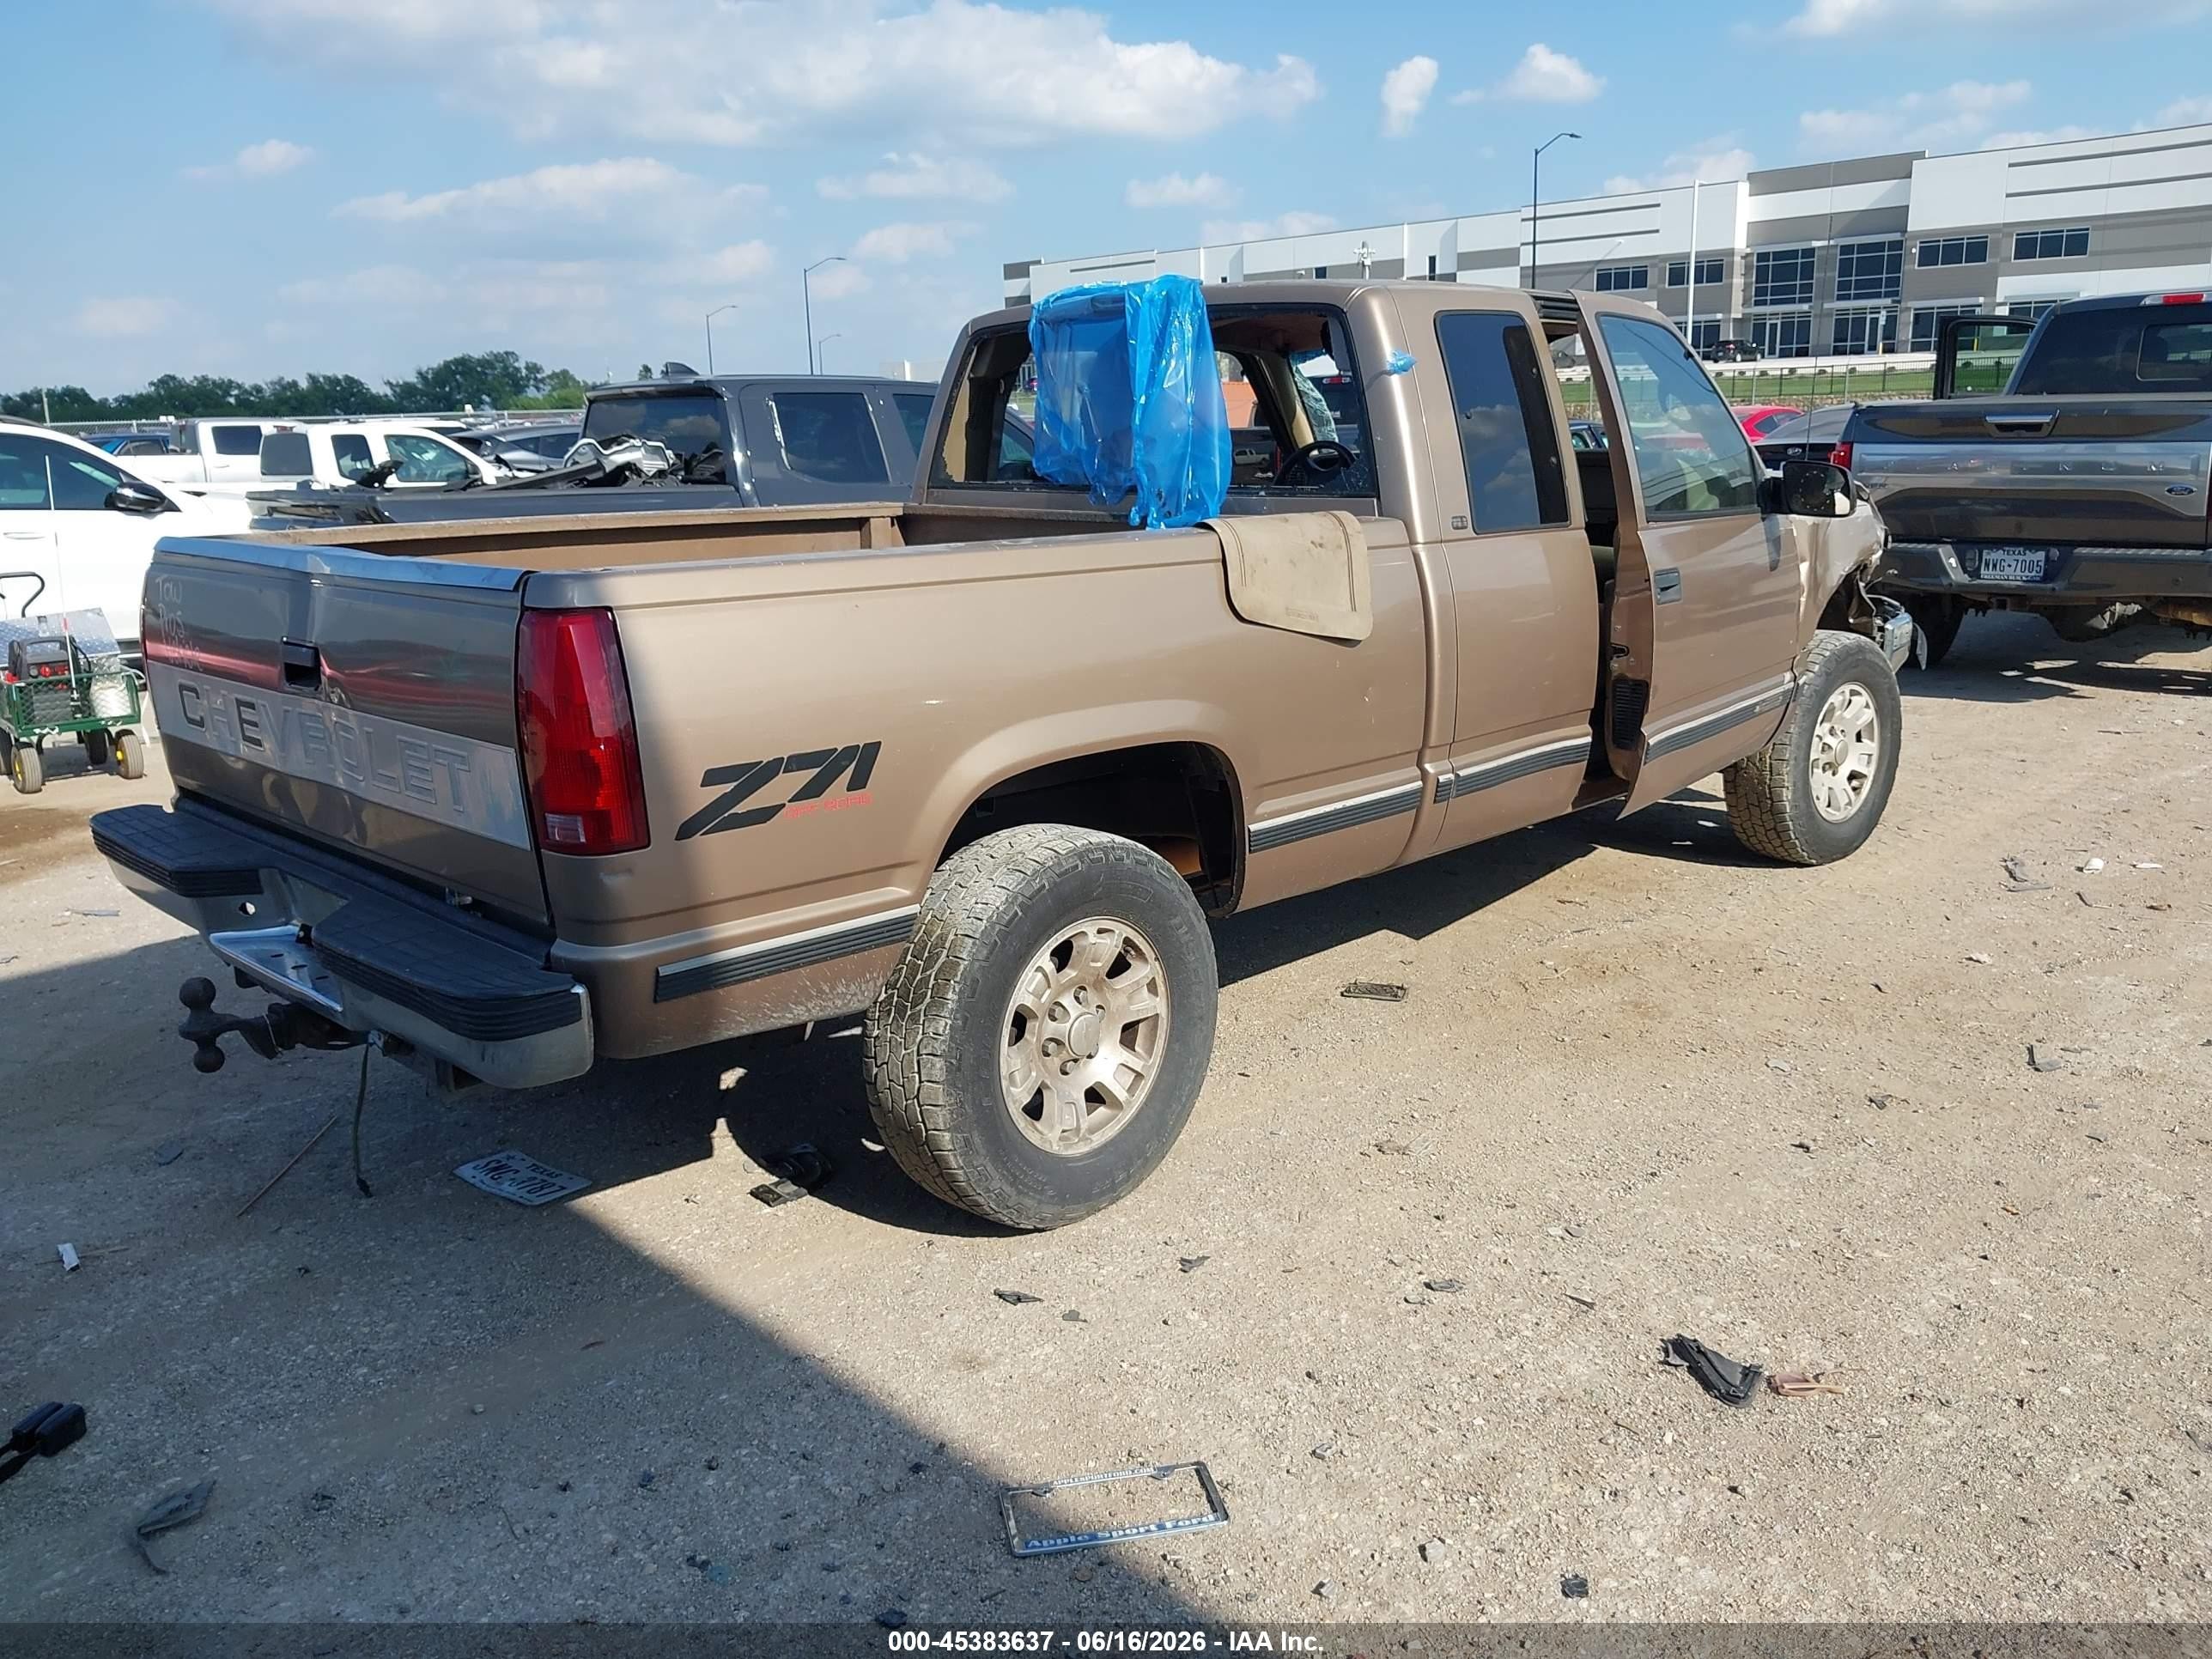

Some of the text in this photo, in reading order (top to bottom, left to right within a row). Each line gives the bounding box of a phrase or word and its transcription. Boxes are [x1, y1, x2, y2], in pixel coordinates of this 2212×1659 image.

[178, 679, 471, 812] CHEVROLET
[674, 740, 882, 842] Z71
[526, 1164, 563, 1180] TEXAS
[1028, 1513, 1217, 1547] Apple Sport Ford
